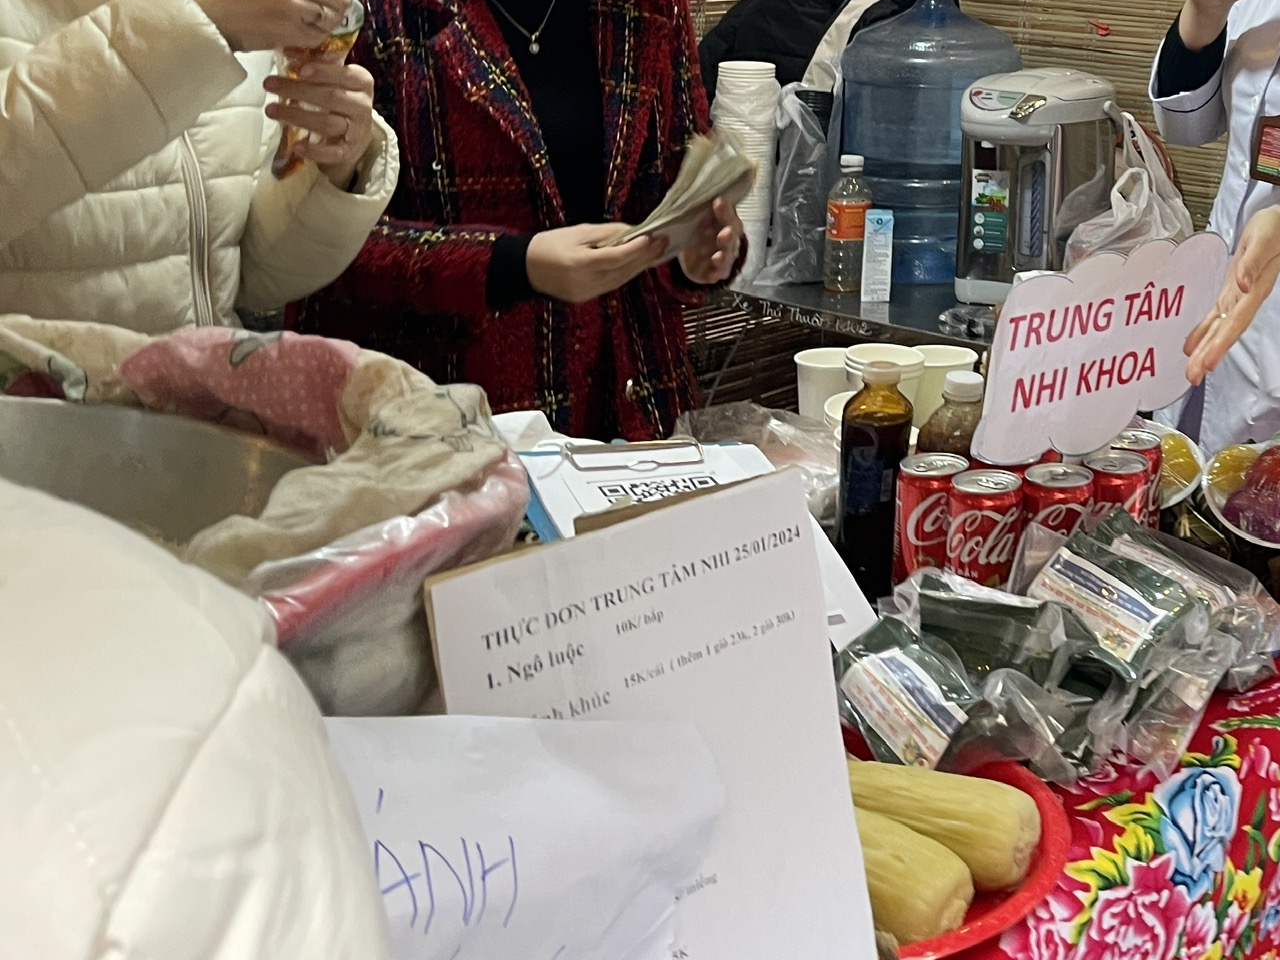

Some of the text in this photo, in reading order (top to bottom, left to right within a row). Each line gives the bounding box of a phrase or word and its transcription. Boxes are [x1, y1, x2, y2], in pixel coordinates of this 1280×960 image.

[1009, 281, 1185, 352] TRUNG TÂM
[1011, 347, 1156, 413] NHI KHOA
[906, 492, 952, 545] Co
[480, 615, 539, 651] THỰC
[590, 576, 655, 613] TRUNG
[659, 562, 697, 589] TÂM
[701, 550, 730, 571] NHI
[734, 524, 801, 562] 25/01/2024
[487, 672, 502, 690] 1.
[506, 654, 543, 683] Ngô
[549, 642, 585, 668] luộc
[374, 788, 518, 934] ÁNH
